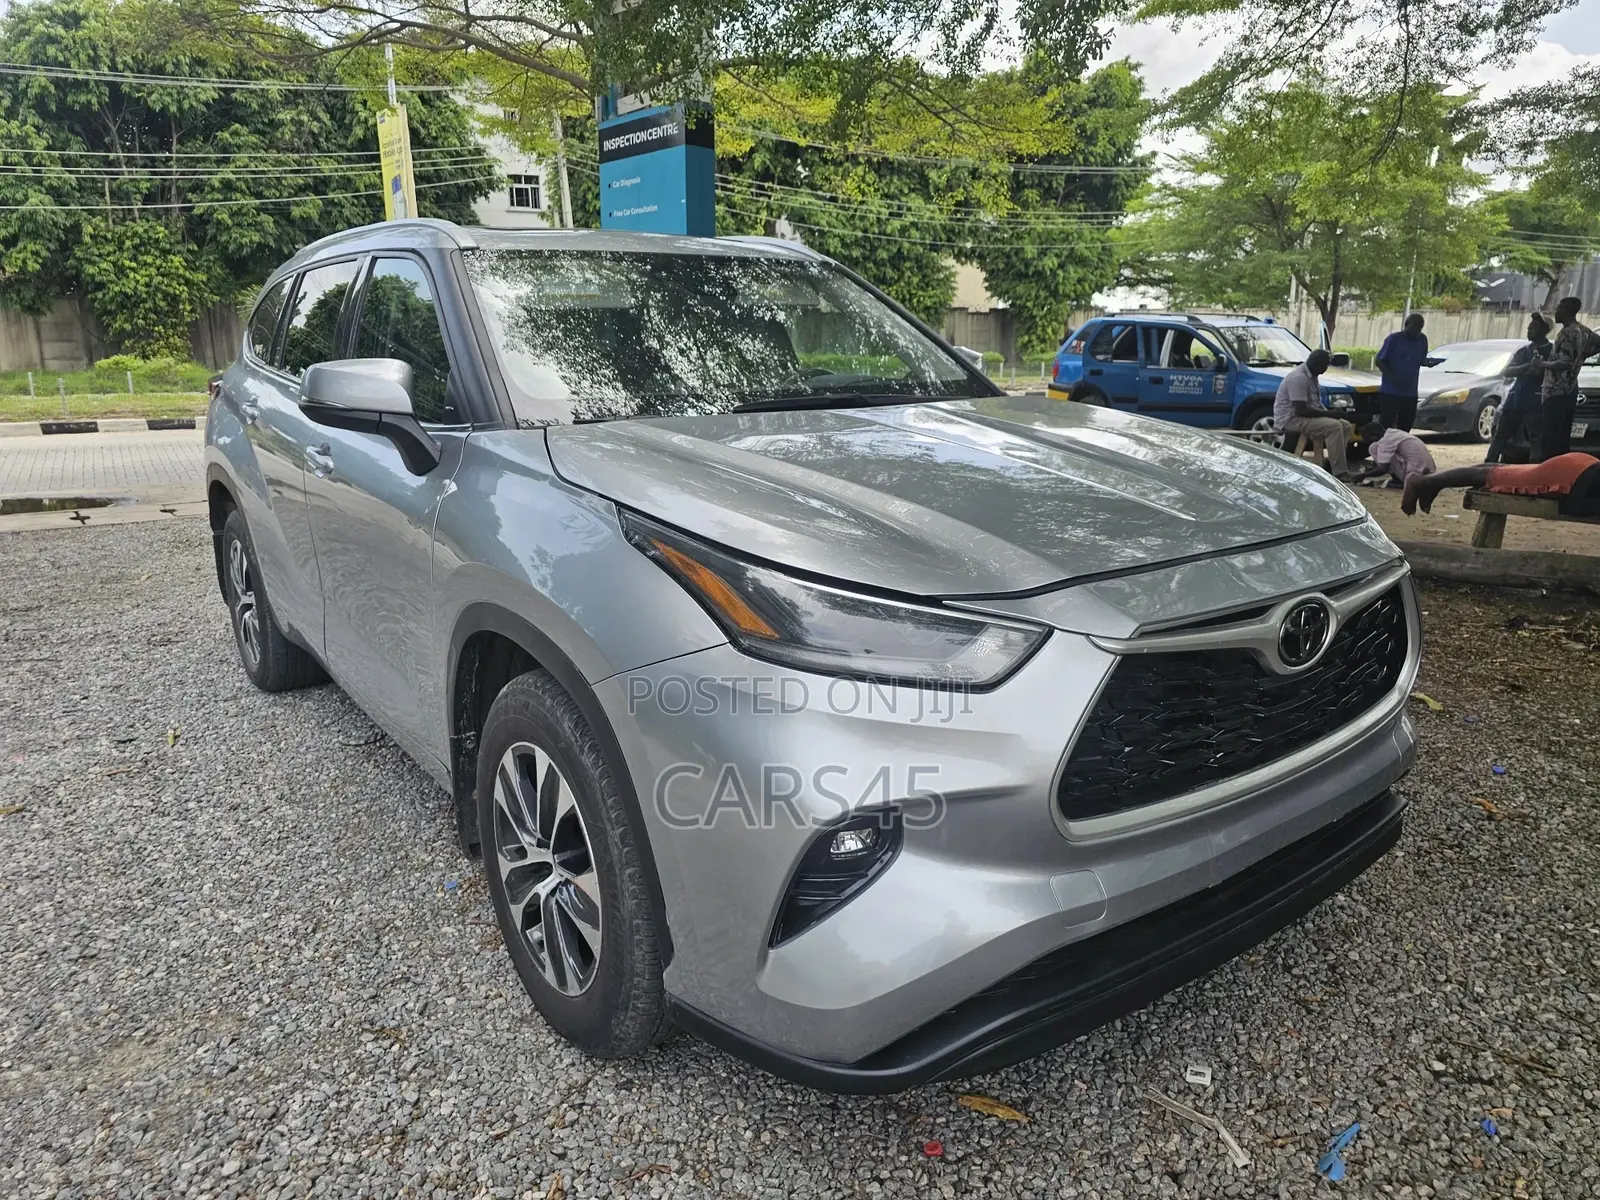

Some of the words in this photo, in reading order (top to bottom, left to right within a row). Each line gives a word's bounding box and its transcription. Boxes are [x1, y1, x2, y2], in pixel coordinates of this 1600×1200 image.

[603, 130, 647, 152] INSPECTION
[647, 122, 679, 141] CENTRE
[612, 180, 620, 188] Car
[620, 177, 641, 187] Diagnosis
[613, 209, 623, 218] Free
[623, 207, 631, 216] Car
[631, 204, 658, 215] Consultation
